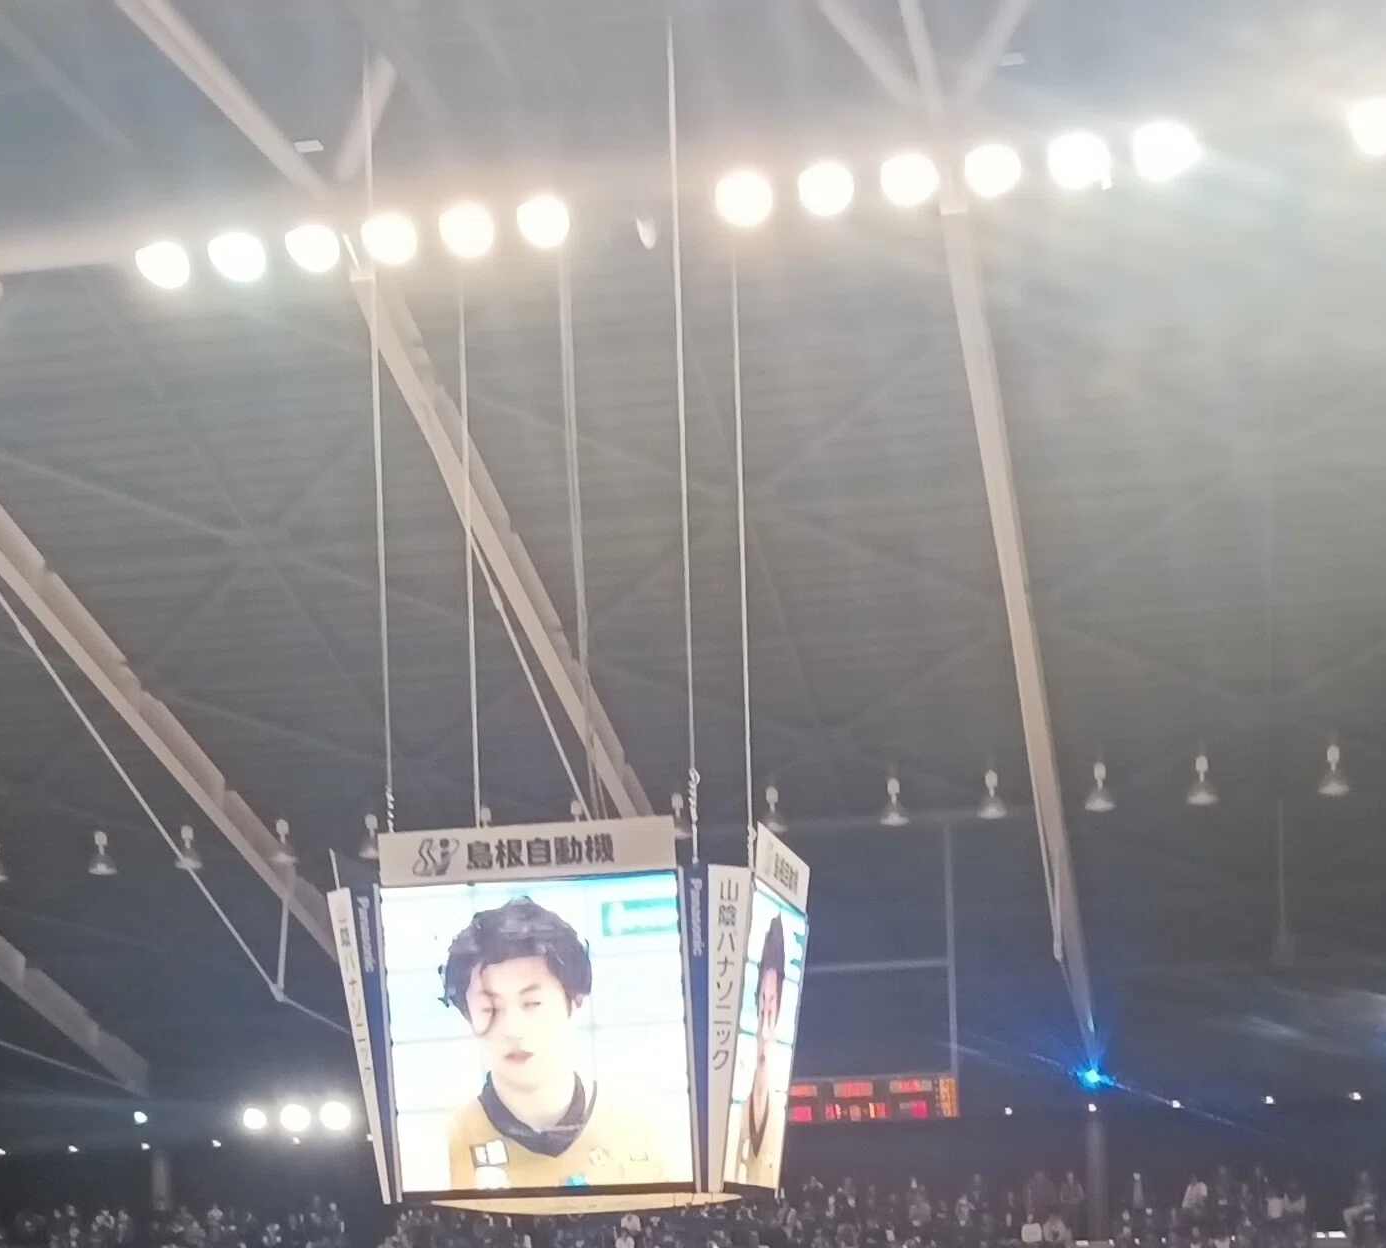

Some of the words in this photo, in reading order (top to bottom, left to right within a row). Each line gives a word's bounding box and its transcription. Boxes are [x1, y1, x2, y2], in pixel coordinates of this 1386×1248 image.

[466, 832, 615, 870] 島根自動機
[712, 878, 740, 1071] 山陰パナソニック
